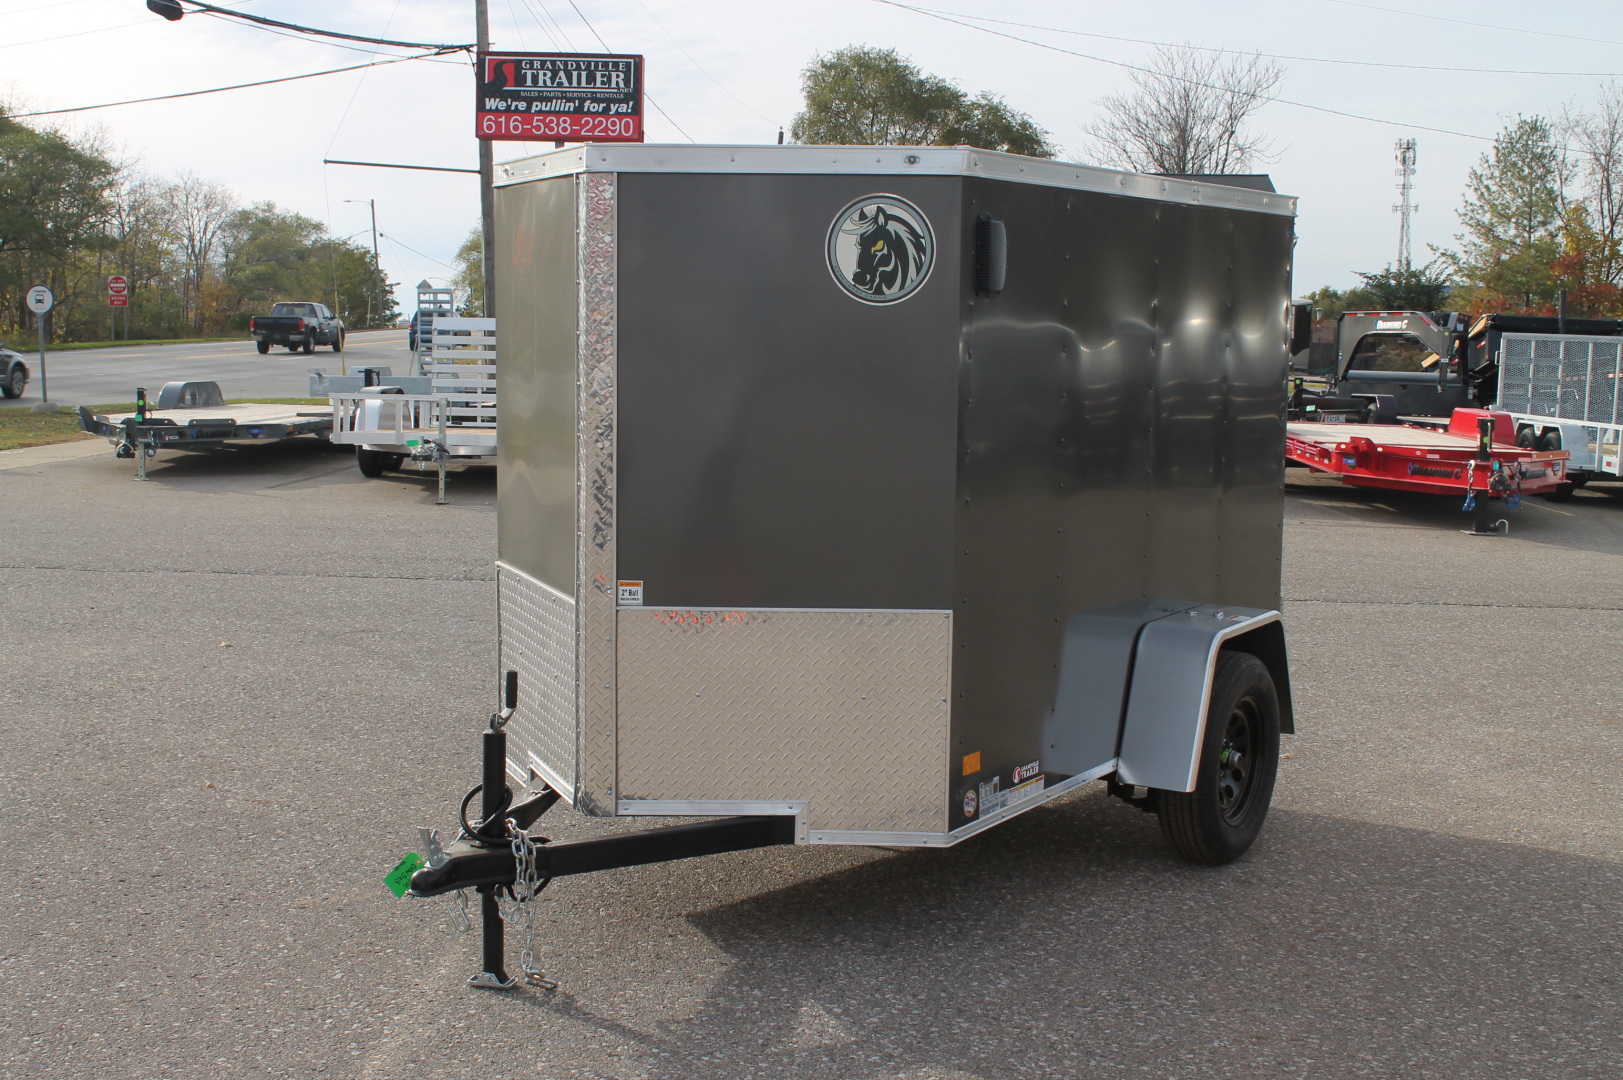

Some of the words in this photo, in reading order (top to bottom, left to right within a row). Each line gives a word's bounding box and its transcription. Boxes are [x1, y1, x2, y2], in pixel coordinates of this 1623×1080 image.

[521, 60, 627, 71] GRANDVILLE
[521, 70, 626, 88] TRAILER
[485, 98, 527, 110] We're
[531, 98, 579, 113] pullin'
[583, 100, 607, 112] for
[609, 101, 634, 114] ya!
[483, 115, 634, 136] 616-538-2290
